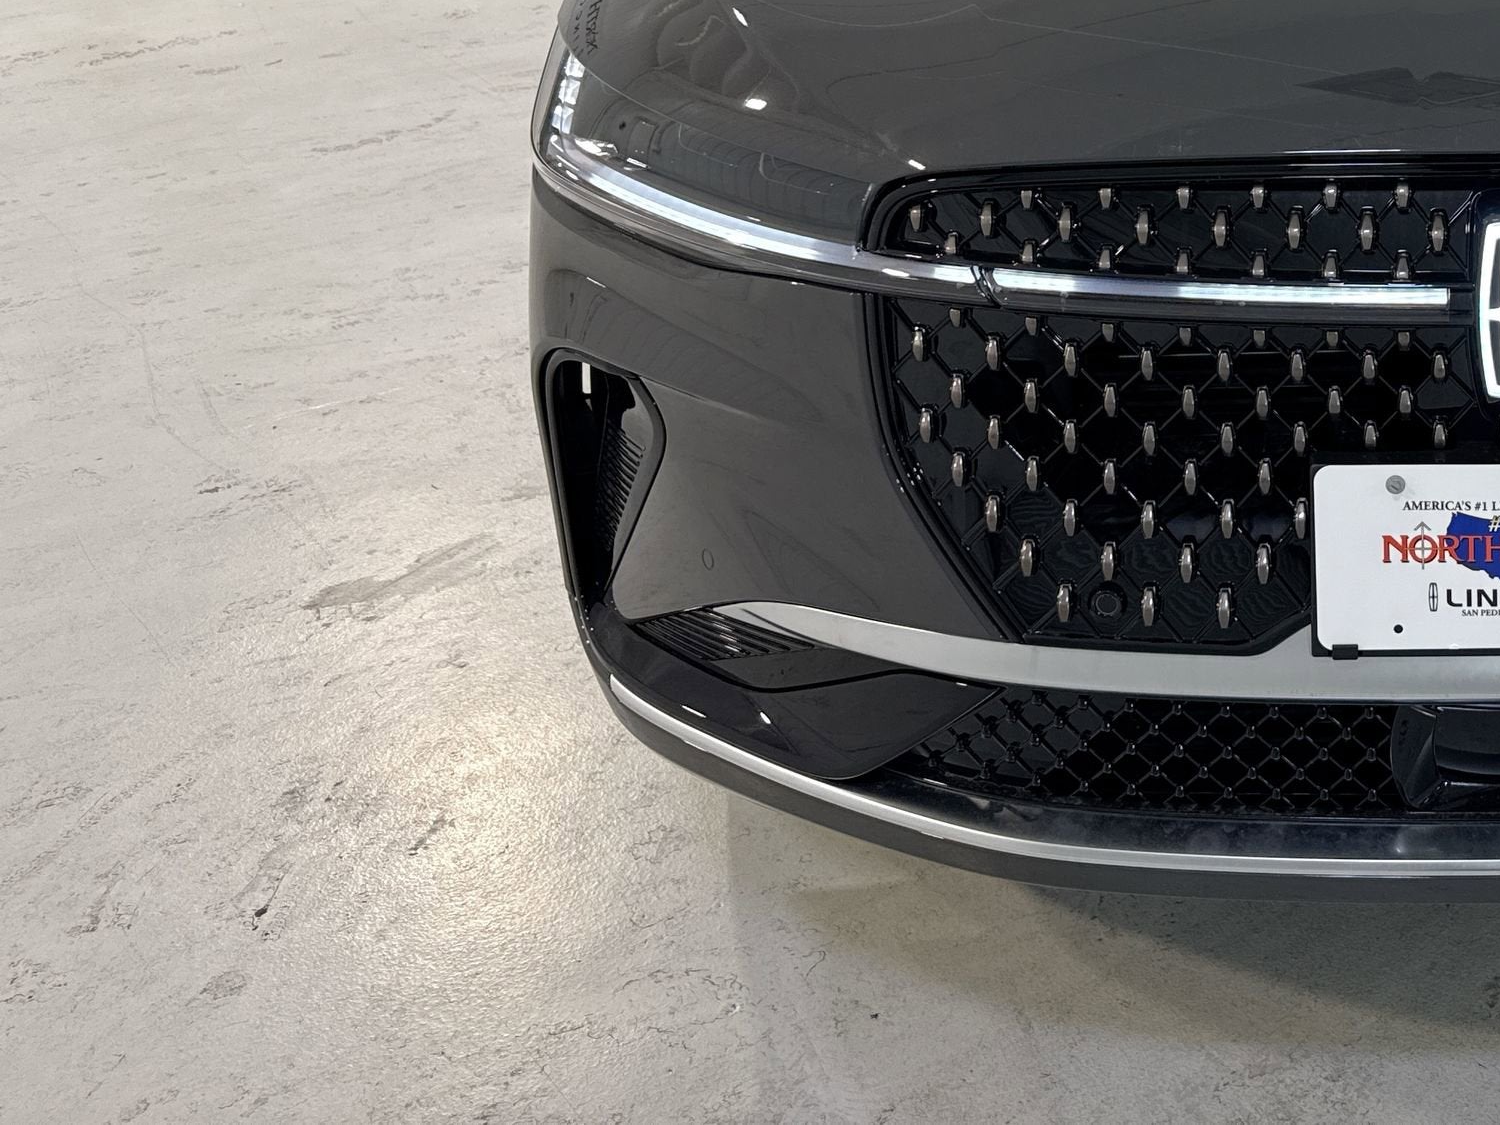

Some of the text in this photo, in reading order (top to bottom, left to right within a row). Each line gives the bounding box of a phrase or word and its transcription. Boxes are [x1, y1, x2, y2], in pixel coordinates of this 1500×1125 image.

[1403, 500, 1471, 511] AMERICA'S
[1474, 501, 1488, 511] #1
[1461, 609, 1479, 617] SAN
